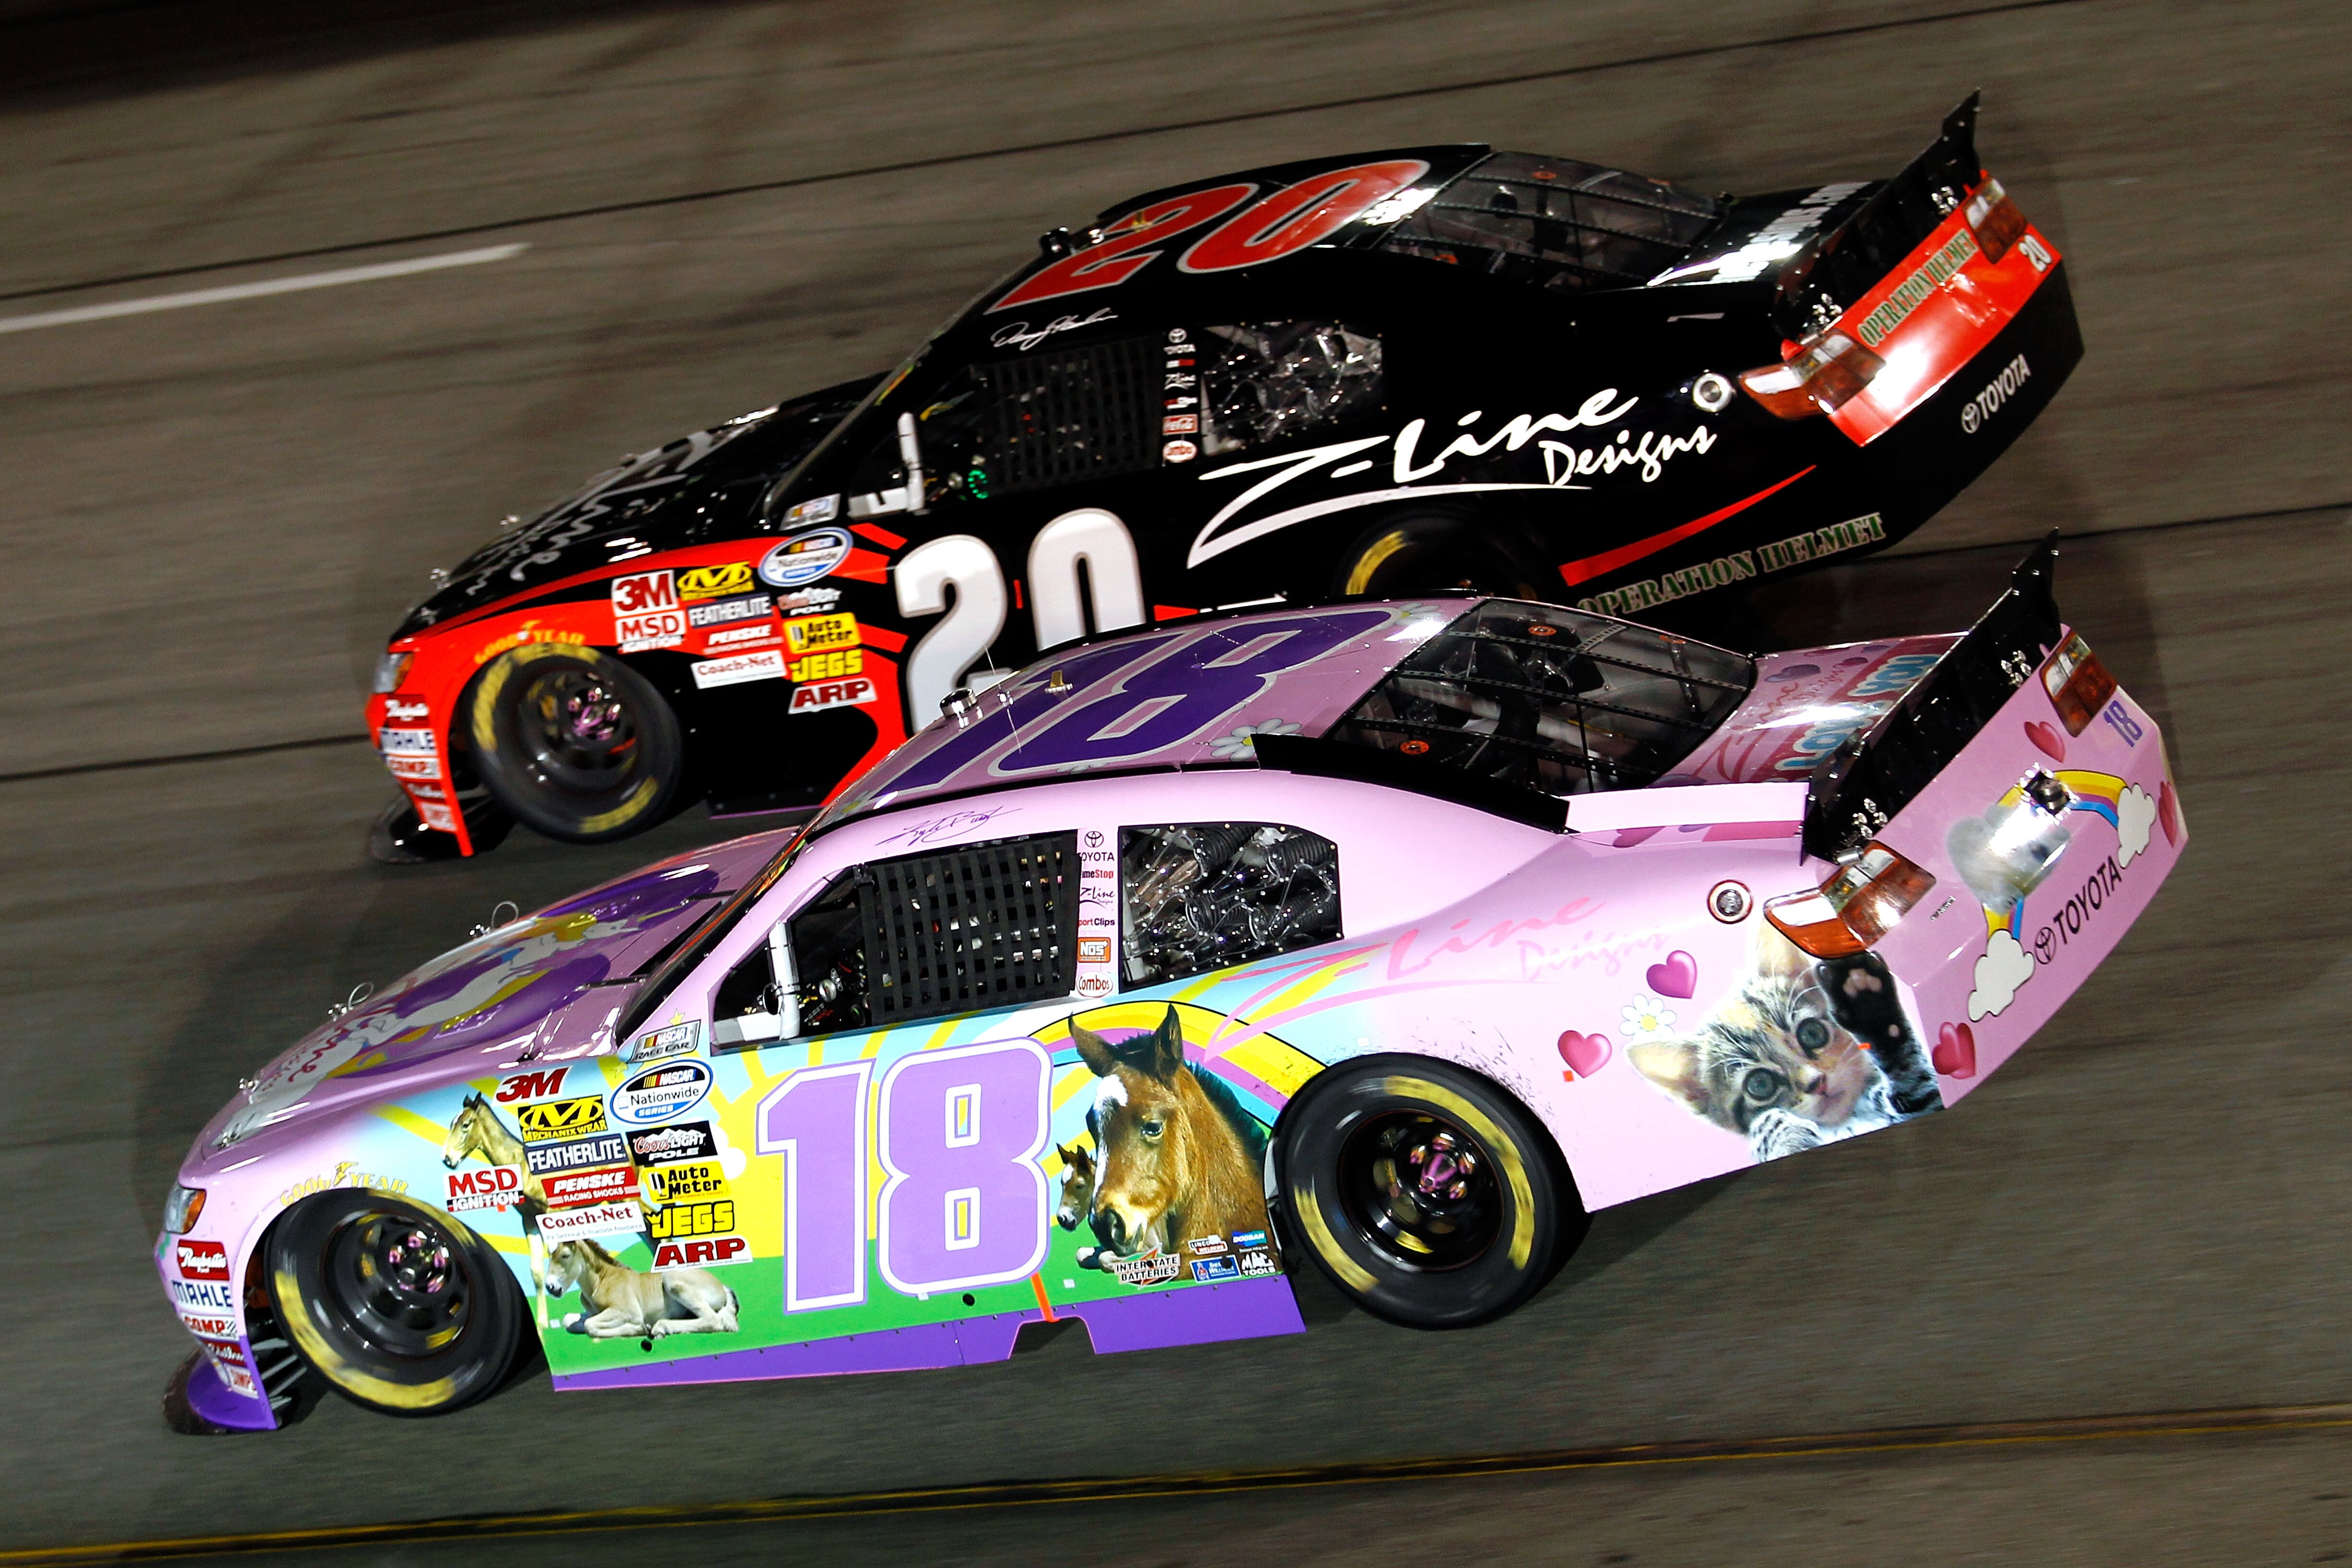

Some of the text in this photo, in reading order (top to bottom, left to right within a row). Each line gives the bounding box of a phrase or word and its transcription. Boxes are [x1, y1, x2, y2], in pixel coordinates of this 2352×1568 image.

[984, 159, 1431, 315] 20
[2019, 234, 2052, 272] 20
[1858, 268, 1938, 347] OPERATION
[1925, 228, 1980, 283] HELMET
[1976, 353, 2032, 419] TOYOTA
[1539, 425, 1716, 486] Designs
[1187, 388, 1639, 568] Z-Line
[1757, 512, 1886, 573] HELMET
[617, 574, 673, 611] 3M
[689, 597, 773, 626] FEATHERLITE
[894, 507, 1146, 734] 20
[622, 615, 679, 640] MSD
[708, 625, 772, 646] PENSKE
[808, 618, 842, 634] Auto
[807, 630, 853, 648] Meter
[791, 649, 863, 683] JEGS
[794, 681, 870, 708] ARP
[870, 608, 1400, 802] 18
[2104, 700, 2144, 747] 18
[2053, 856, 2123, 945] TOYOTA
[1094, 918, 1115, 928] Clips
[1080, 941, 1109, 956] NOS
[1079, 974, 1110, 991] Combos
[656, 1027, 687, 1046] NASCAR
[665, 1042, 689, 1053] CAR
[496, 1066, 570, 1102] 3M
[660, 1068, 695, 1087] NASCAR
[630, 1086, 699, 1106] Nationwide
[638, 1105, 674, 1117] SERIES
[576, 1119, 607, 1134] WEAR
[527, 1138, 625, 1172] FEATHERLITE
[633, 1133, 707, 1154] Coors LIGHT
[649, 1147, 699, 1162] POLE
[349, 1172, 409, 1195] YEAR
[449, 1169, 518, 1197] MSD
[553, 1171, 626, 1194] PENSKE
[668, 1167, 709, 1182] Auto
[757, 1037, 1054, 1314] 18
[563, 1187, 624, 1203] RACING SHOCKS
[668, 1179, 722, 1198] Meter
[452, 1191, 519, 1212] IGNITION
[542, 1206, 633, 1229] Coach-Net
[652, 1201, 734, 1238] JEGS
[655, 1237, 745, 1267] ARP
[1241, 1252, 1274, 1270] MAC
[1116, 1256, 1178, 1272] INTERTATE
[1121, 1266, 1176, 1282] BATTERIES
[1243, 1266, 1276, 1276] TOOLS
[172, 1280, 234, 1308] MAHLE
[185, 1316, 225, 1334] COMP
